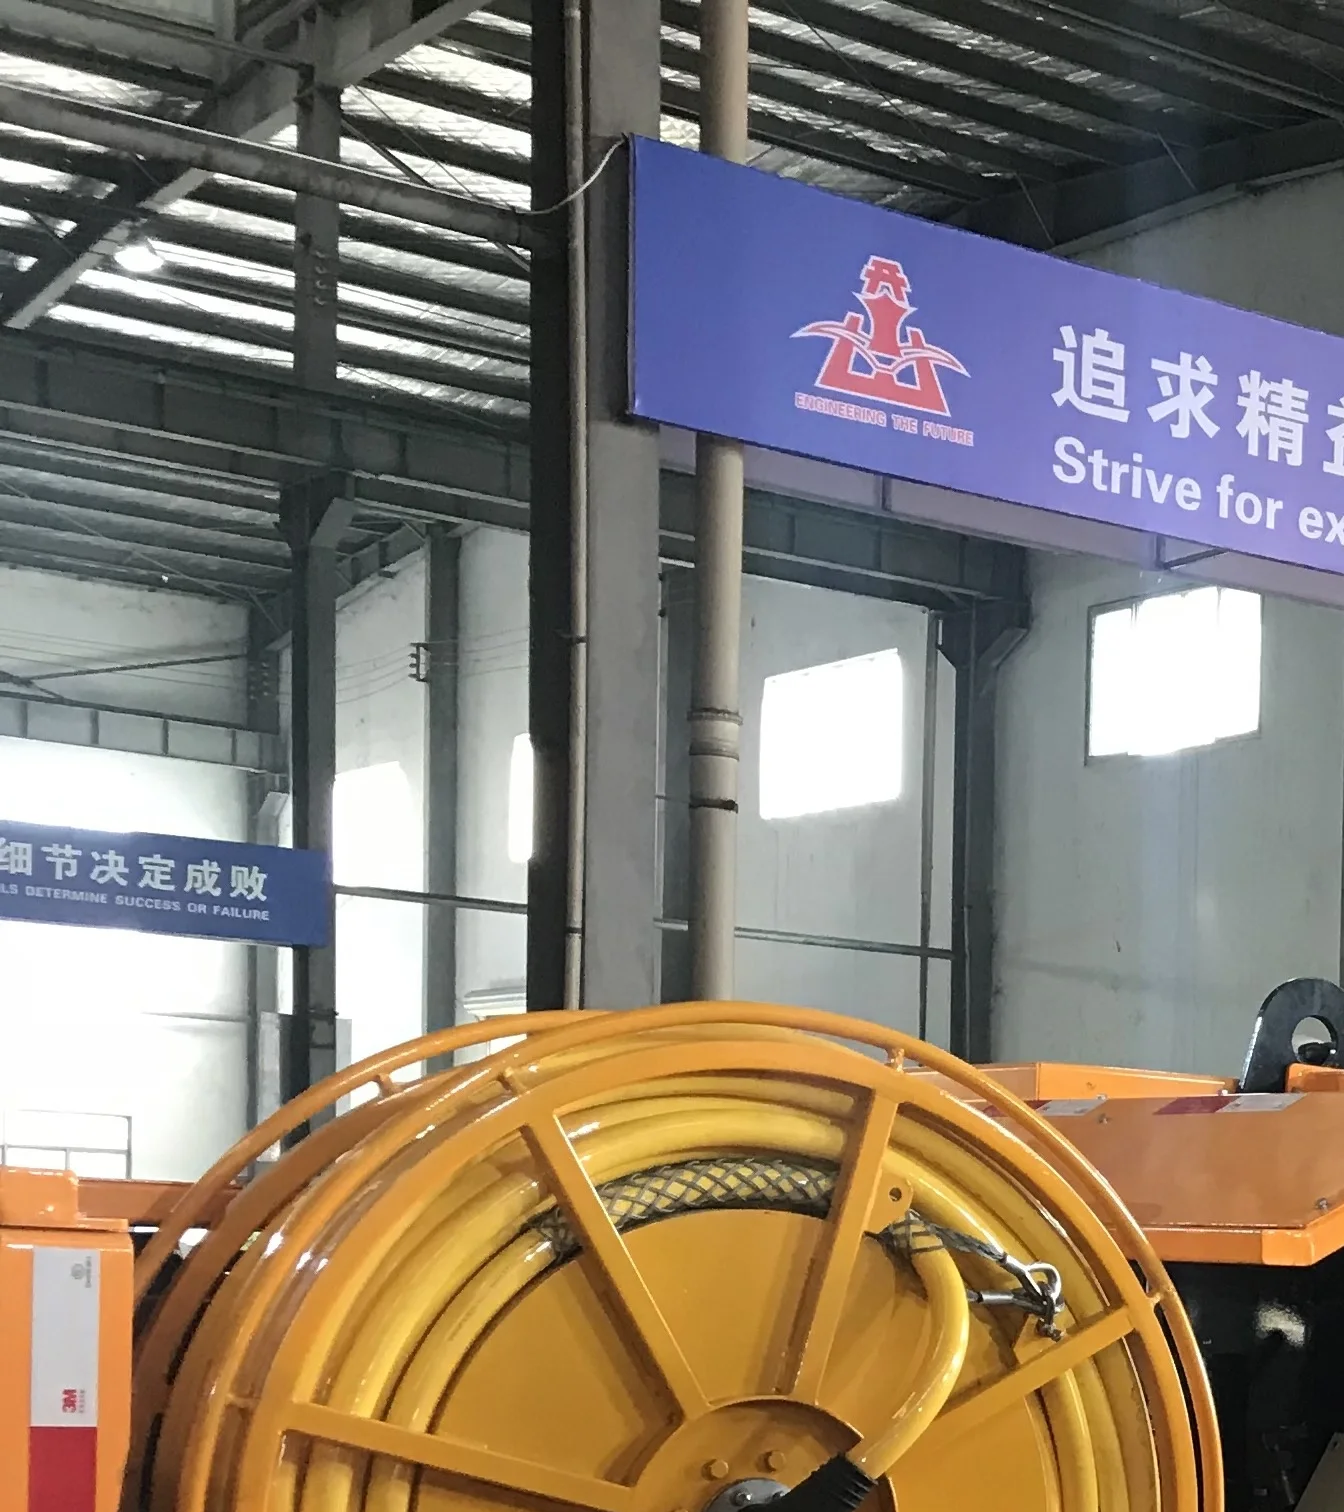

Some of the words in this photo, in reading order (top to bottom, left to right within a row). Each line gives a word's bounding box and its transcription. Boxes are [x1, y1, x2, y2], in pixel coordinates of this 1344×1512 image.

[795, 392, 886, 427] ENGINEERING
[891, 414, 918, 434] THE
[923, 421, 974, 446] FUTURE
[1053, 436, 1200, 510] Strive
[1216, 474, 1283, 526] for
[0, 838, 268, 901] 细节决定成败
[25, 886, 108, 904] DETERMINE
[115, 894, 181, 912] SUCCESS
[187, 902, 207, 914] OR
[213, 906, 270, 921] FAILURE
[62, 1389, 77, 1413] 3M
